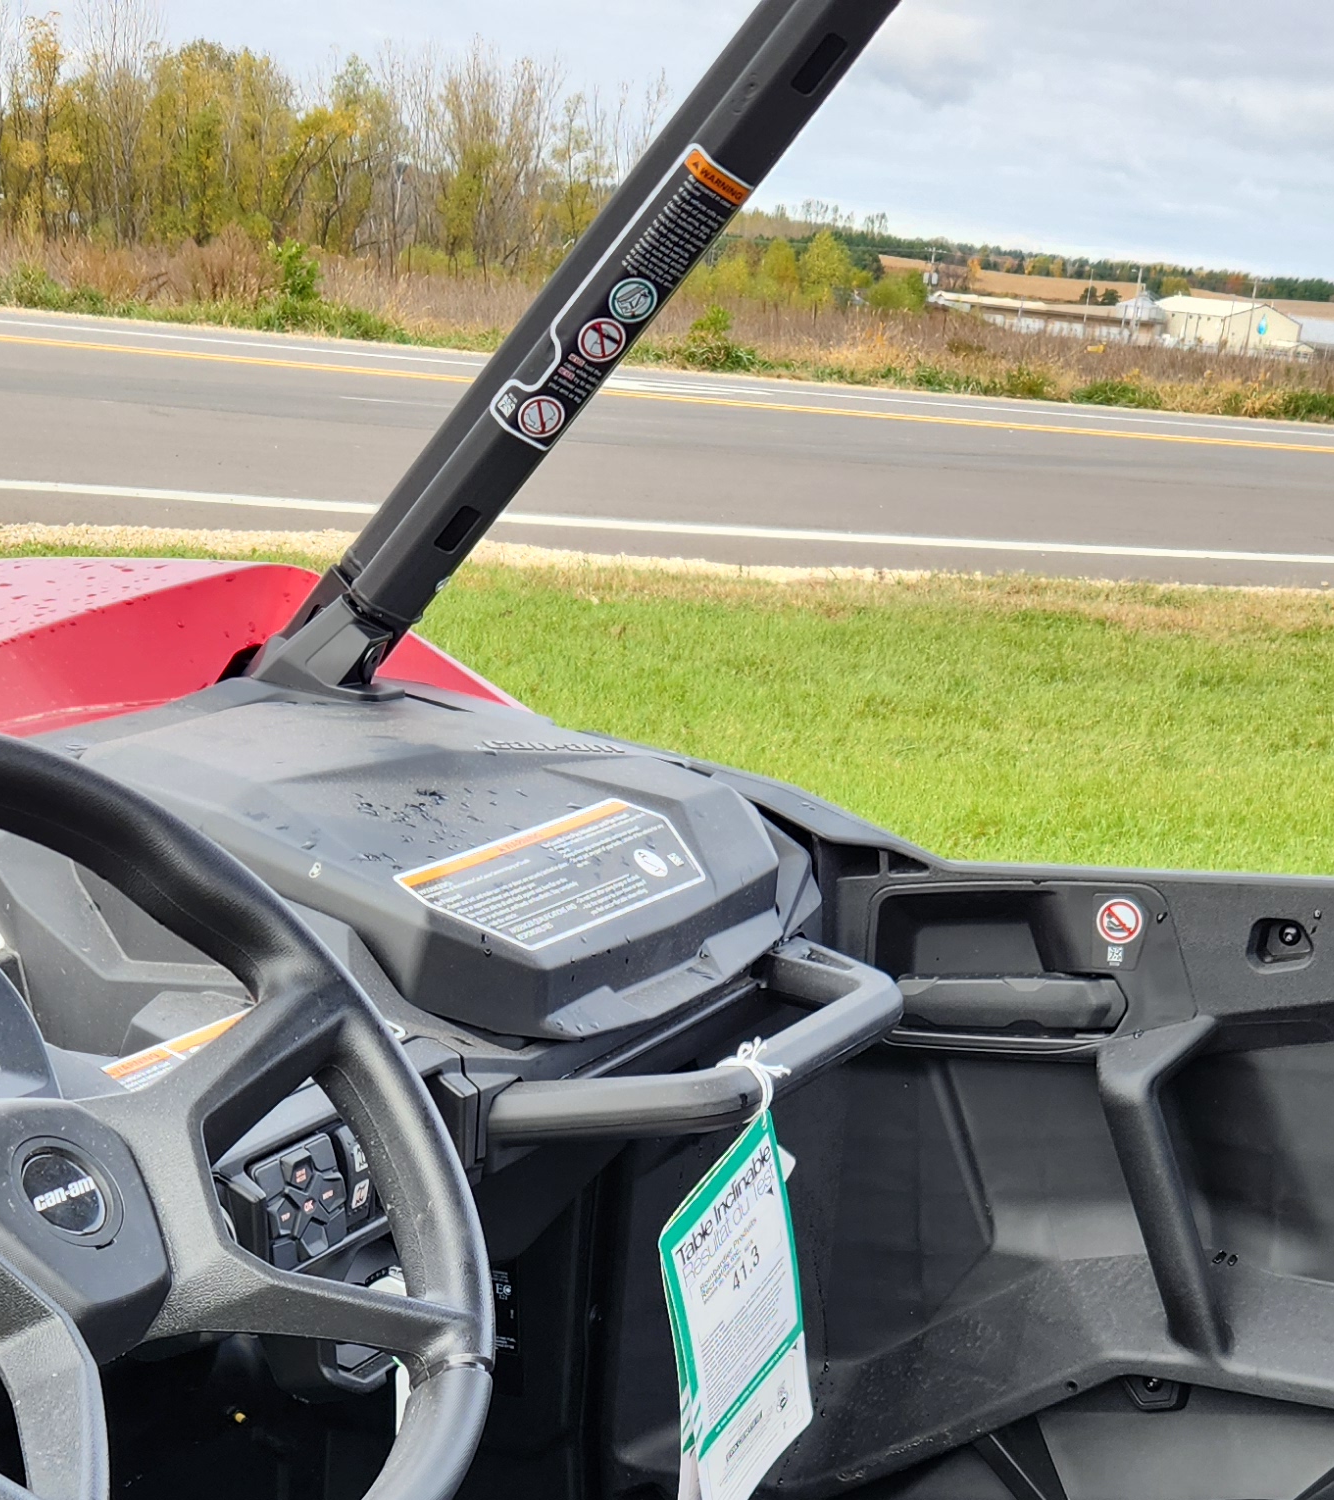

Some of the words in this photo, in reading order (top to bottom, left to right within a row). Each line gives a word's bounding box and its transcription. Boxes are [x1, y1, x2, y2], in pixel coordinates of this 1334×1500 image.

[700, 167, 743, 202] WARNING
[33, 1176, 95, 1212] can-am
[753, 1163, 776, 1203] Test
[304, 1200, 315, 1213] OK
[675, 1219, 715, 1266] Table
[713, 1144, 772, 1225] Inclinable
[733, 1245, 761, 1291] 41.3
